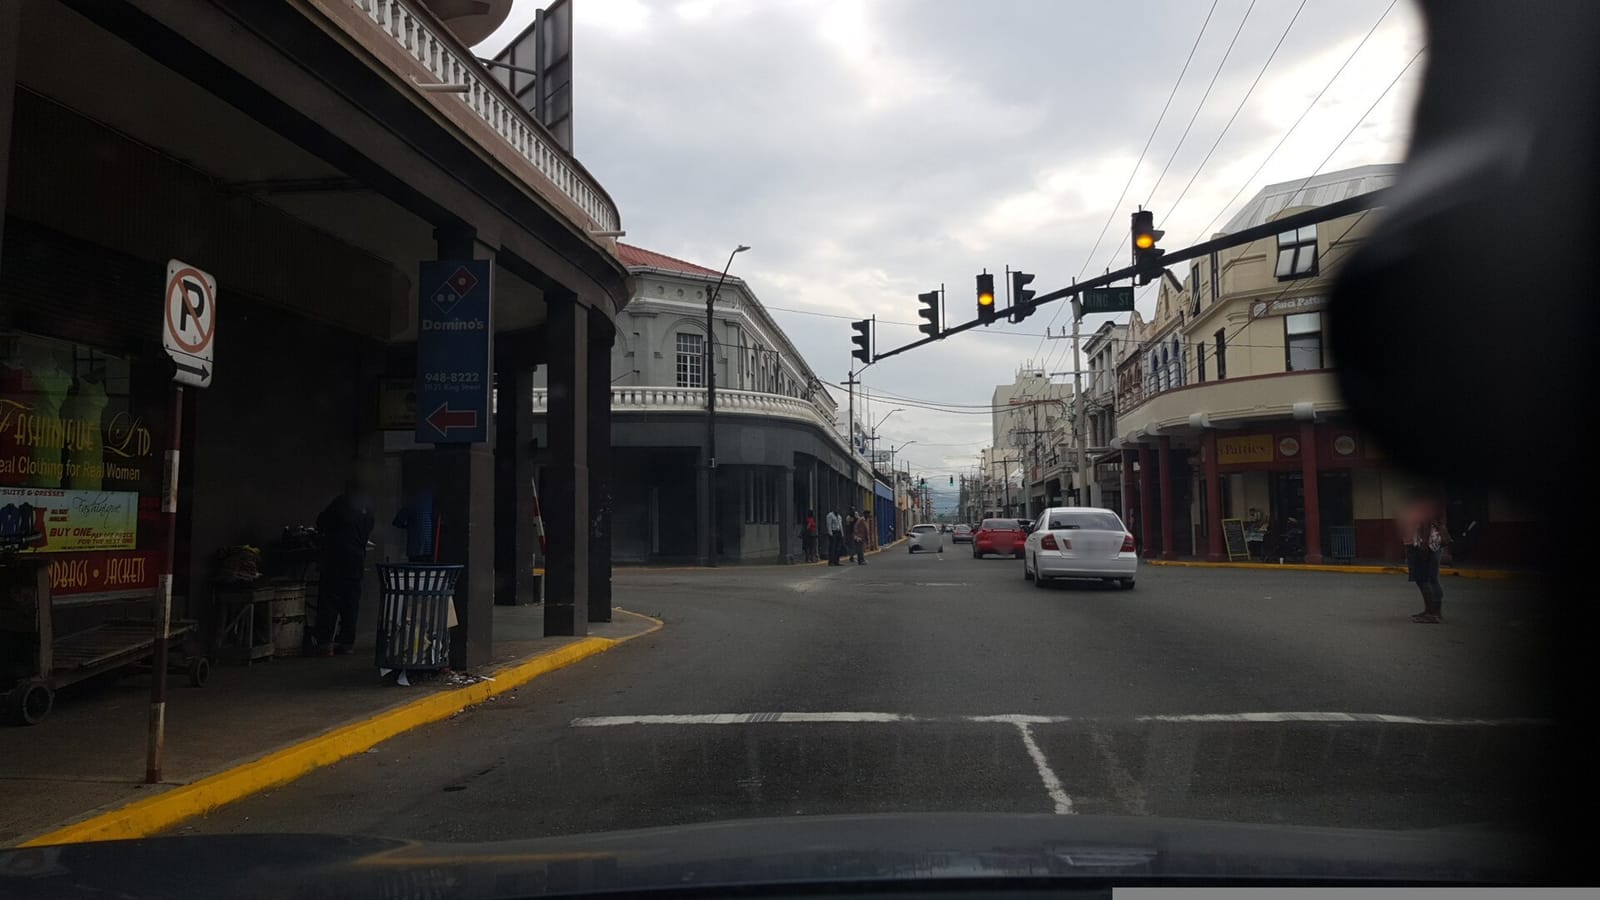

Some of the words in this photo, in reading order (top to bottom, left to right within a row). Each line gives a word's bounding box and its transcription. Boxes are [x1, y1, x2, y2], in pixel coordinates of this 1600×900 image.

[1118, 292, 1130, 306] ST
[422, 317, 484, 331] Domino's
[424, 372, 480, 383] 948-8222
[0, 455, 16, 474] eal
[18, 455, 63, 480] Clothing
[66, 459, 81, 477] for
[83, 460, 105, 478] Real
[106, 462, 141, 481] Women
[49, 527, 71, 537] BUY
[73, 527, 92, 537] ONE
[48, 559, 88, 588] NDBAGS
[104, 557, 146, 585] JACKETS
